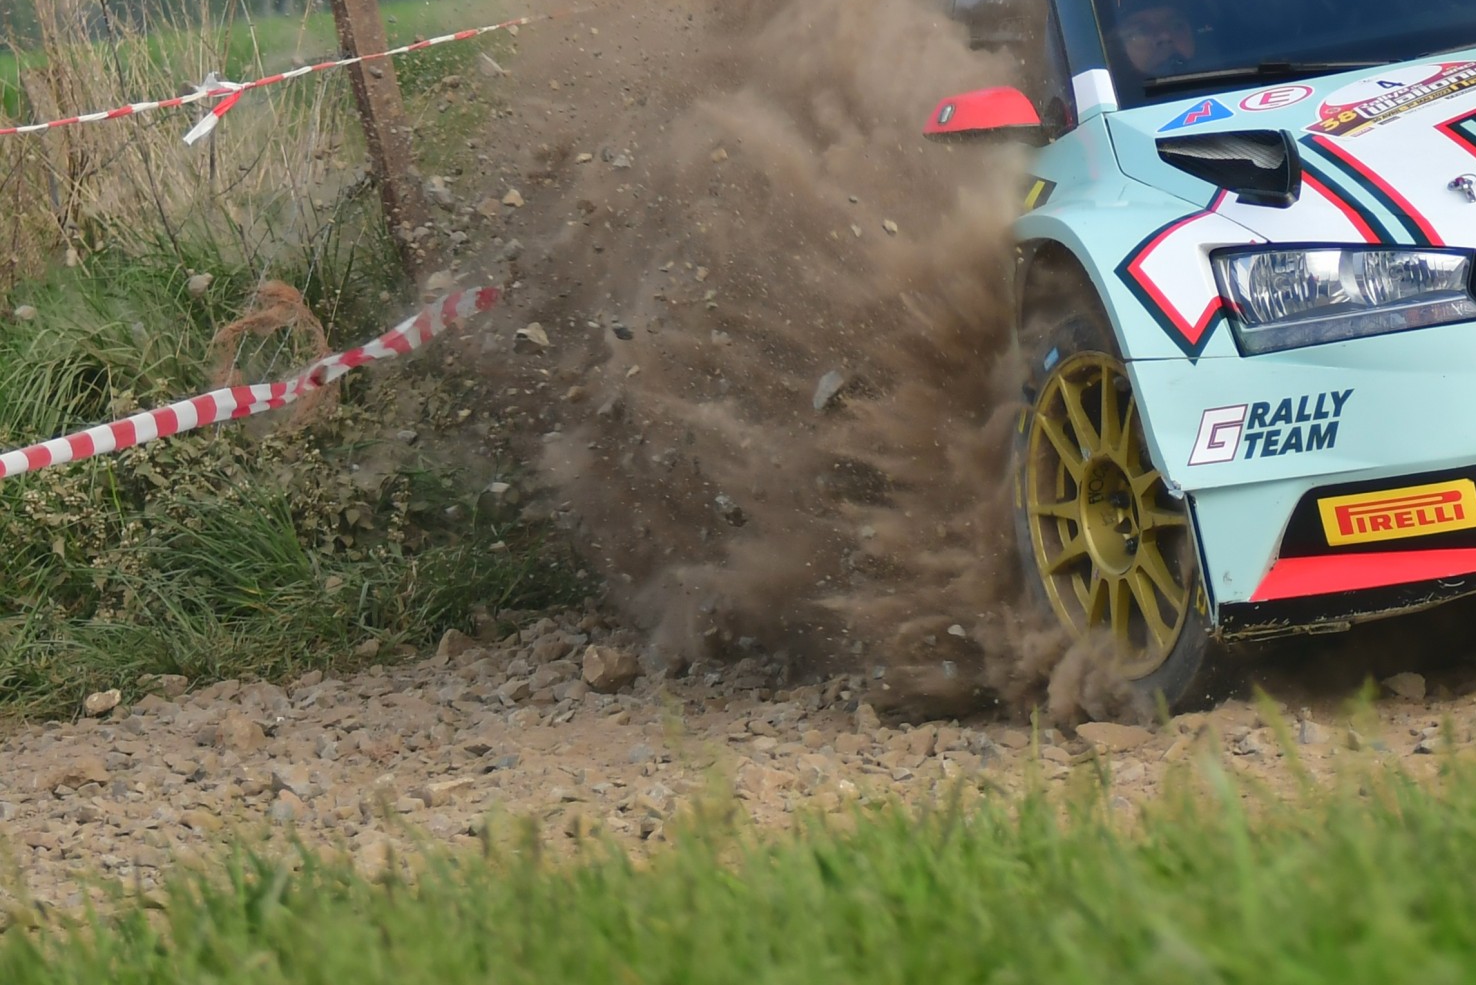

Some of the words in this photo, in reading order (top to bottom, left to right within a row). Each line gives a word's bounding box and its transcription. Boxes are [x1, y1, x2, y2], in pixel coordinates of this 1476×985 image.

[1260, 90, 1296, 106] E
[1376, 80, 1407, 90] 4
[1319, 110, 1358, 132] 38
[1247, 388, 1355, 430] RALLY
[1244, 421, 1339, 459] TEAM
[1335, 490, 1466, 536] PIRELLI
